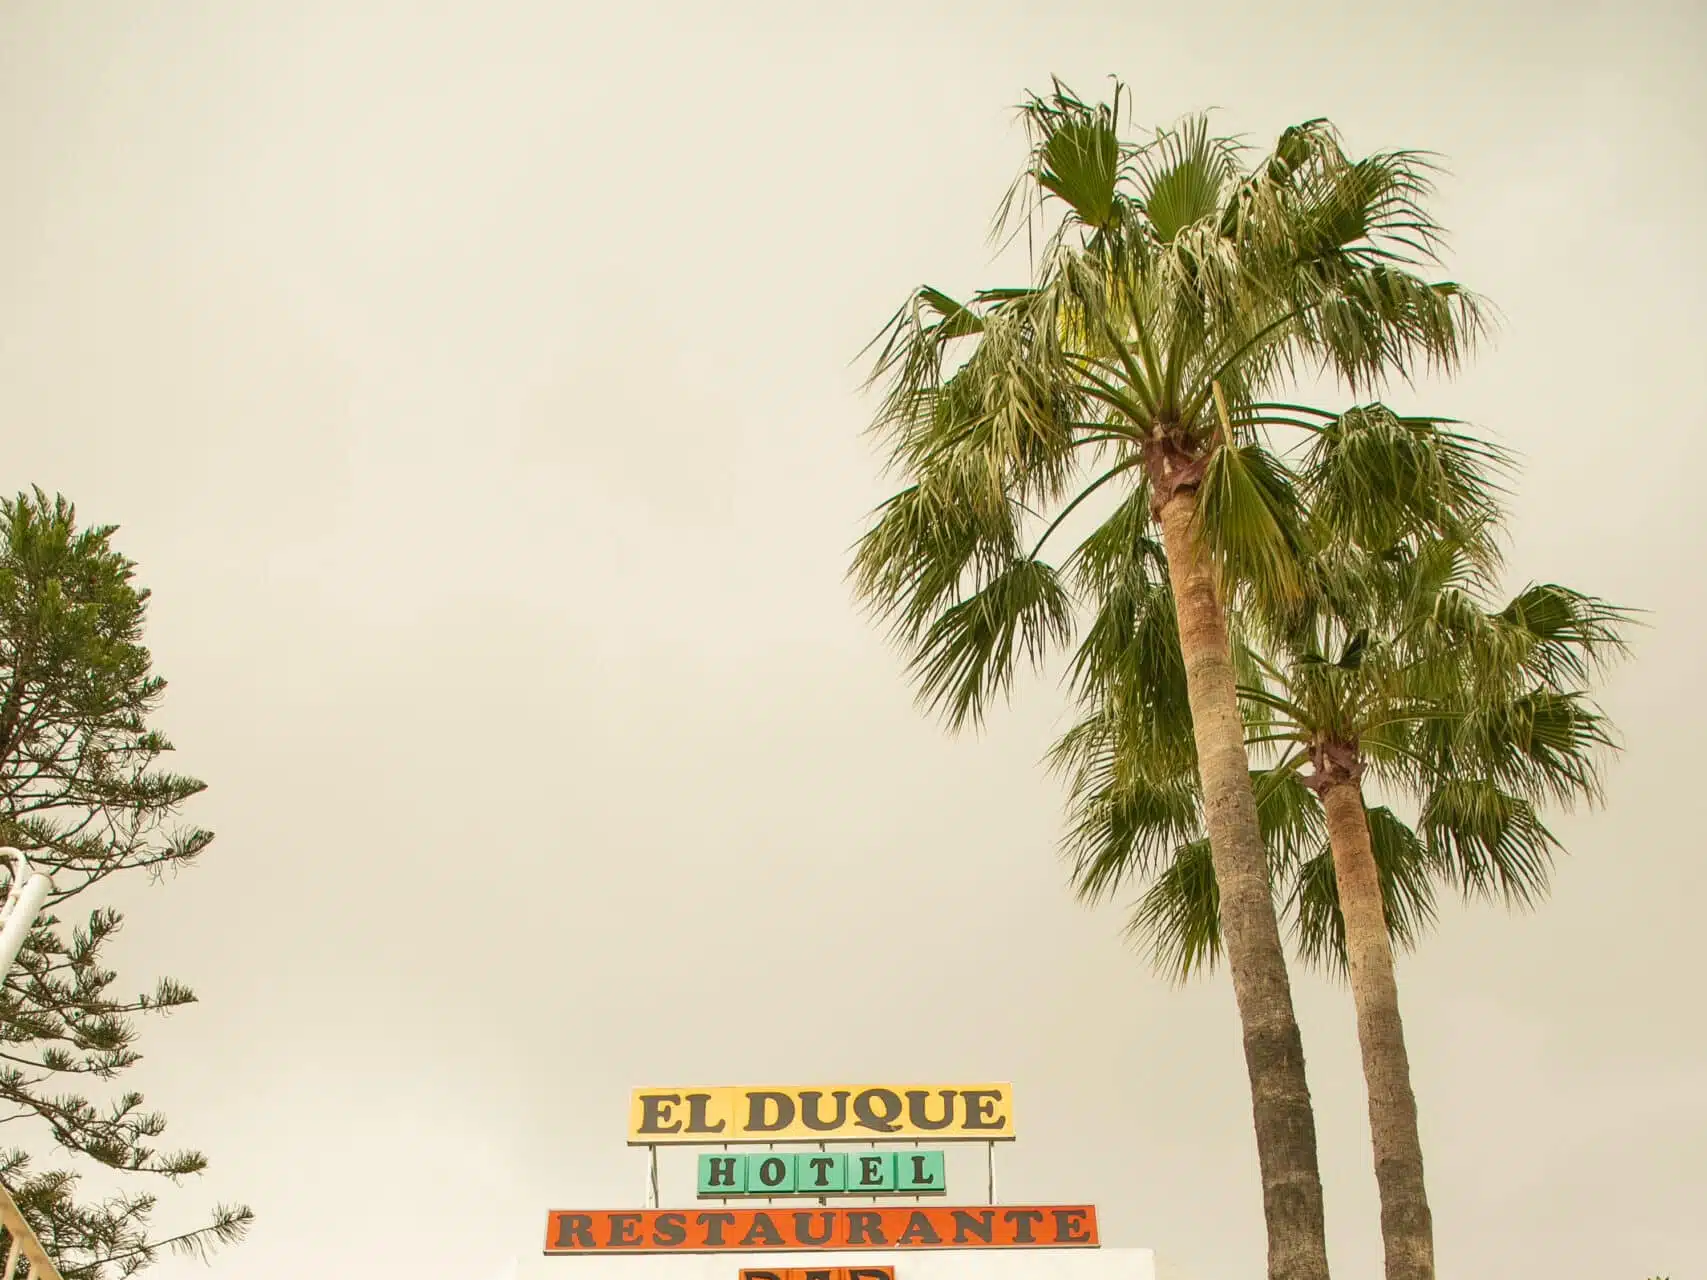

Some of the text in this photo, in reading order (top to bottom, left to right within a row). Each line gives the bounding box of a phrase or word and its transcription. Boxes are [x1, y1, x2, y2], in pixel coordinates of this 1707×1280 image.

[637, 1088, 1007, 1134] EL DUQUE
[708, 1156, 934, 1186] HOTEL
[554, 1210, 1090, 1247] RESTAURANTE
